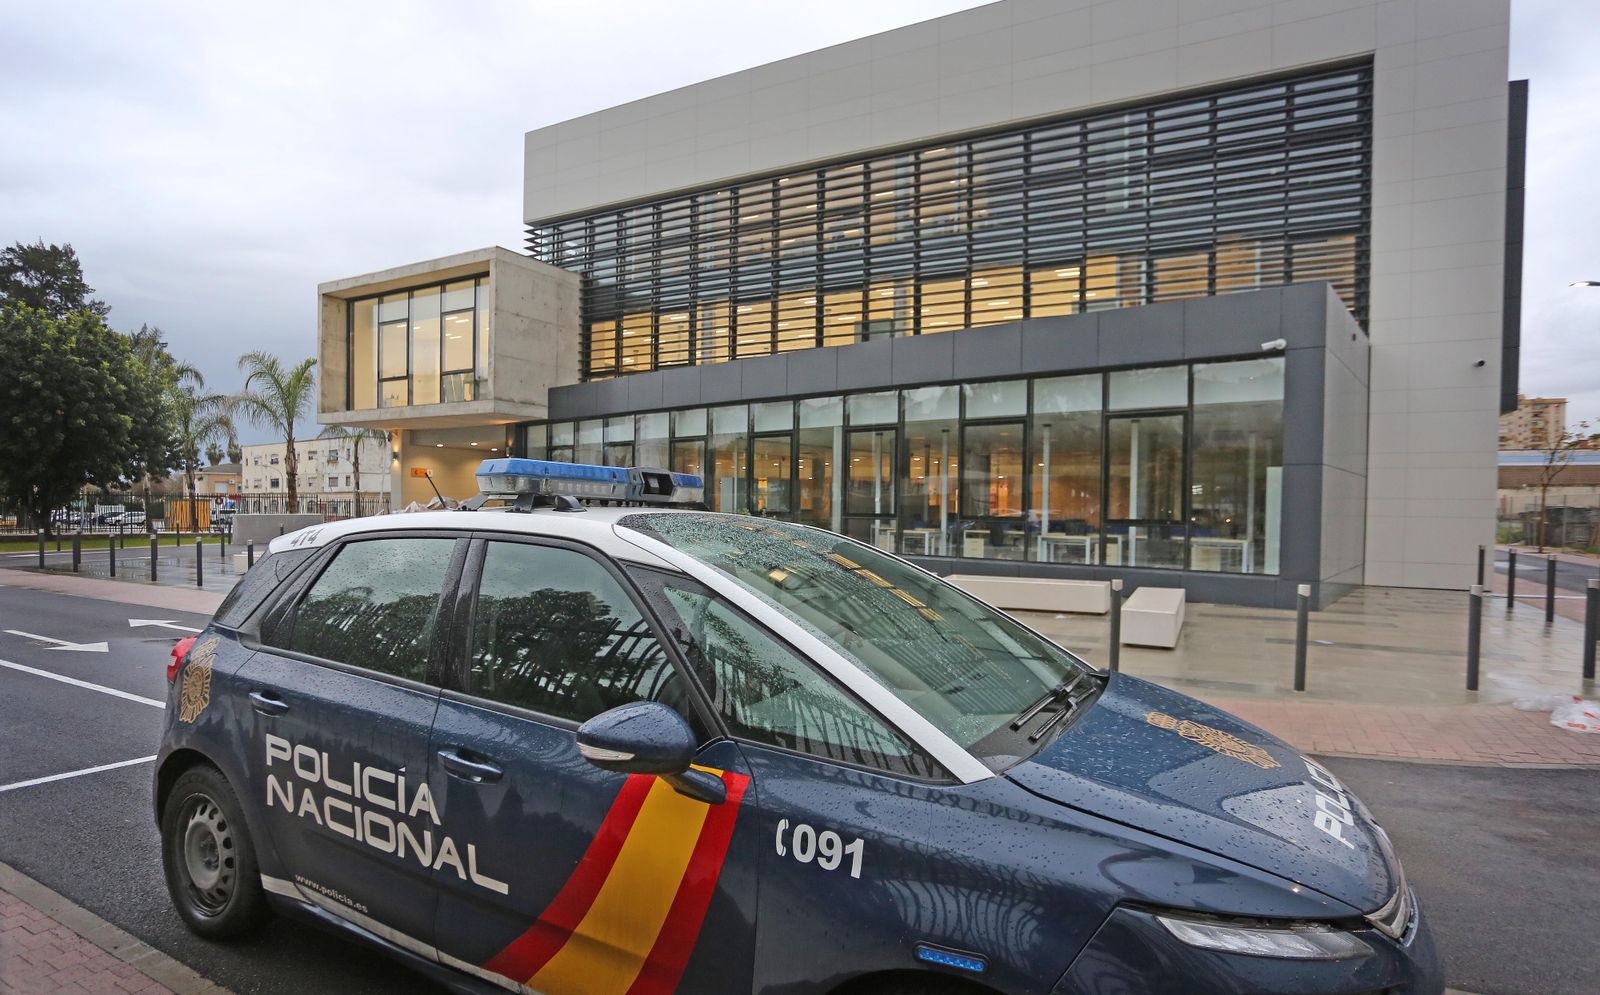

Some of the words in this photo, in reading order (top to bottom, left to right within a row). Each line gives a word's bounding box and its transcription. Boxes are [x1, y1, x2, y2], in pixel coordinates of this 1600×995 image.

[265, 733, 442, 826] POLICÍA
[266, 774, 509, 895] NACIONAL
[792, 823, 865, 879] 091
[294, 873, 369, 914] www.policia.es
